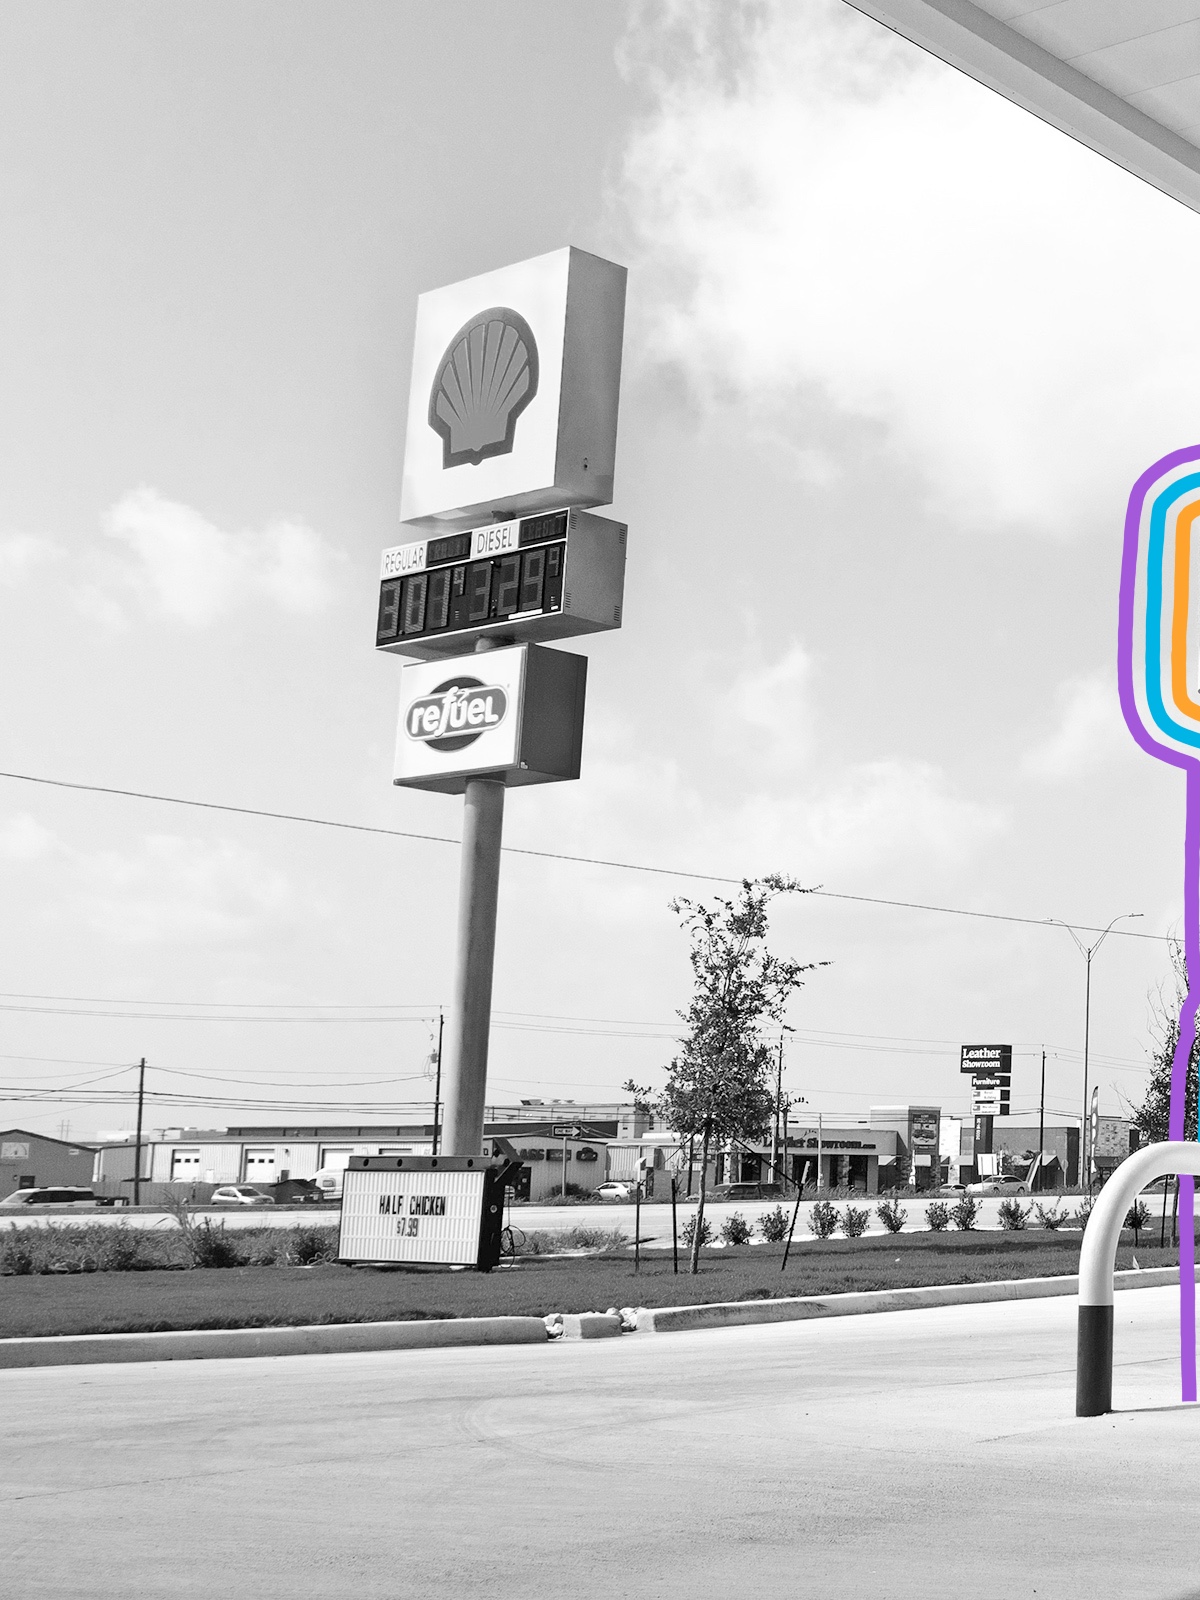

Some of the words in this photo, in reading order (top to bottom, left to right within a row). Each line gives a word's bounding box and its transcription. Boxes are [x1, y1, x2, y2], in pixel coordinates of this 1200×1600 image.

[476, 527, 512, 553] DIESEL
[385, 547, 424, 572] REGULAR
[962, 1047, 1001, 1059] Leather
[961, 1060, 1001, 1068] Showroom
[972, 1078, 1000, 1086] Furniture
[379, 1195, 403, 1215] HALF
[410, 1196, 446, 1216] CHICKEN
